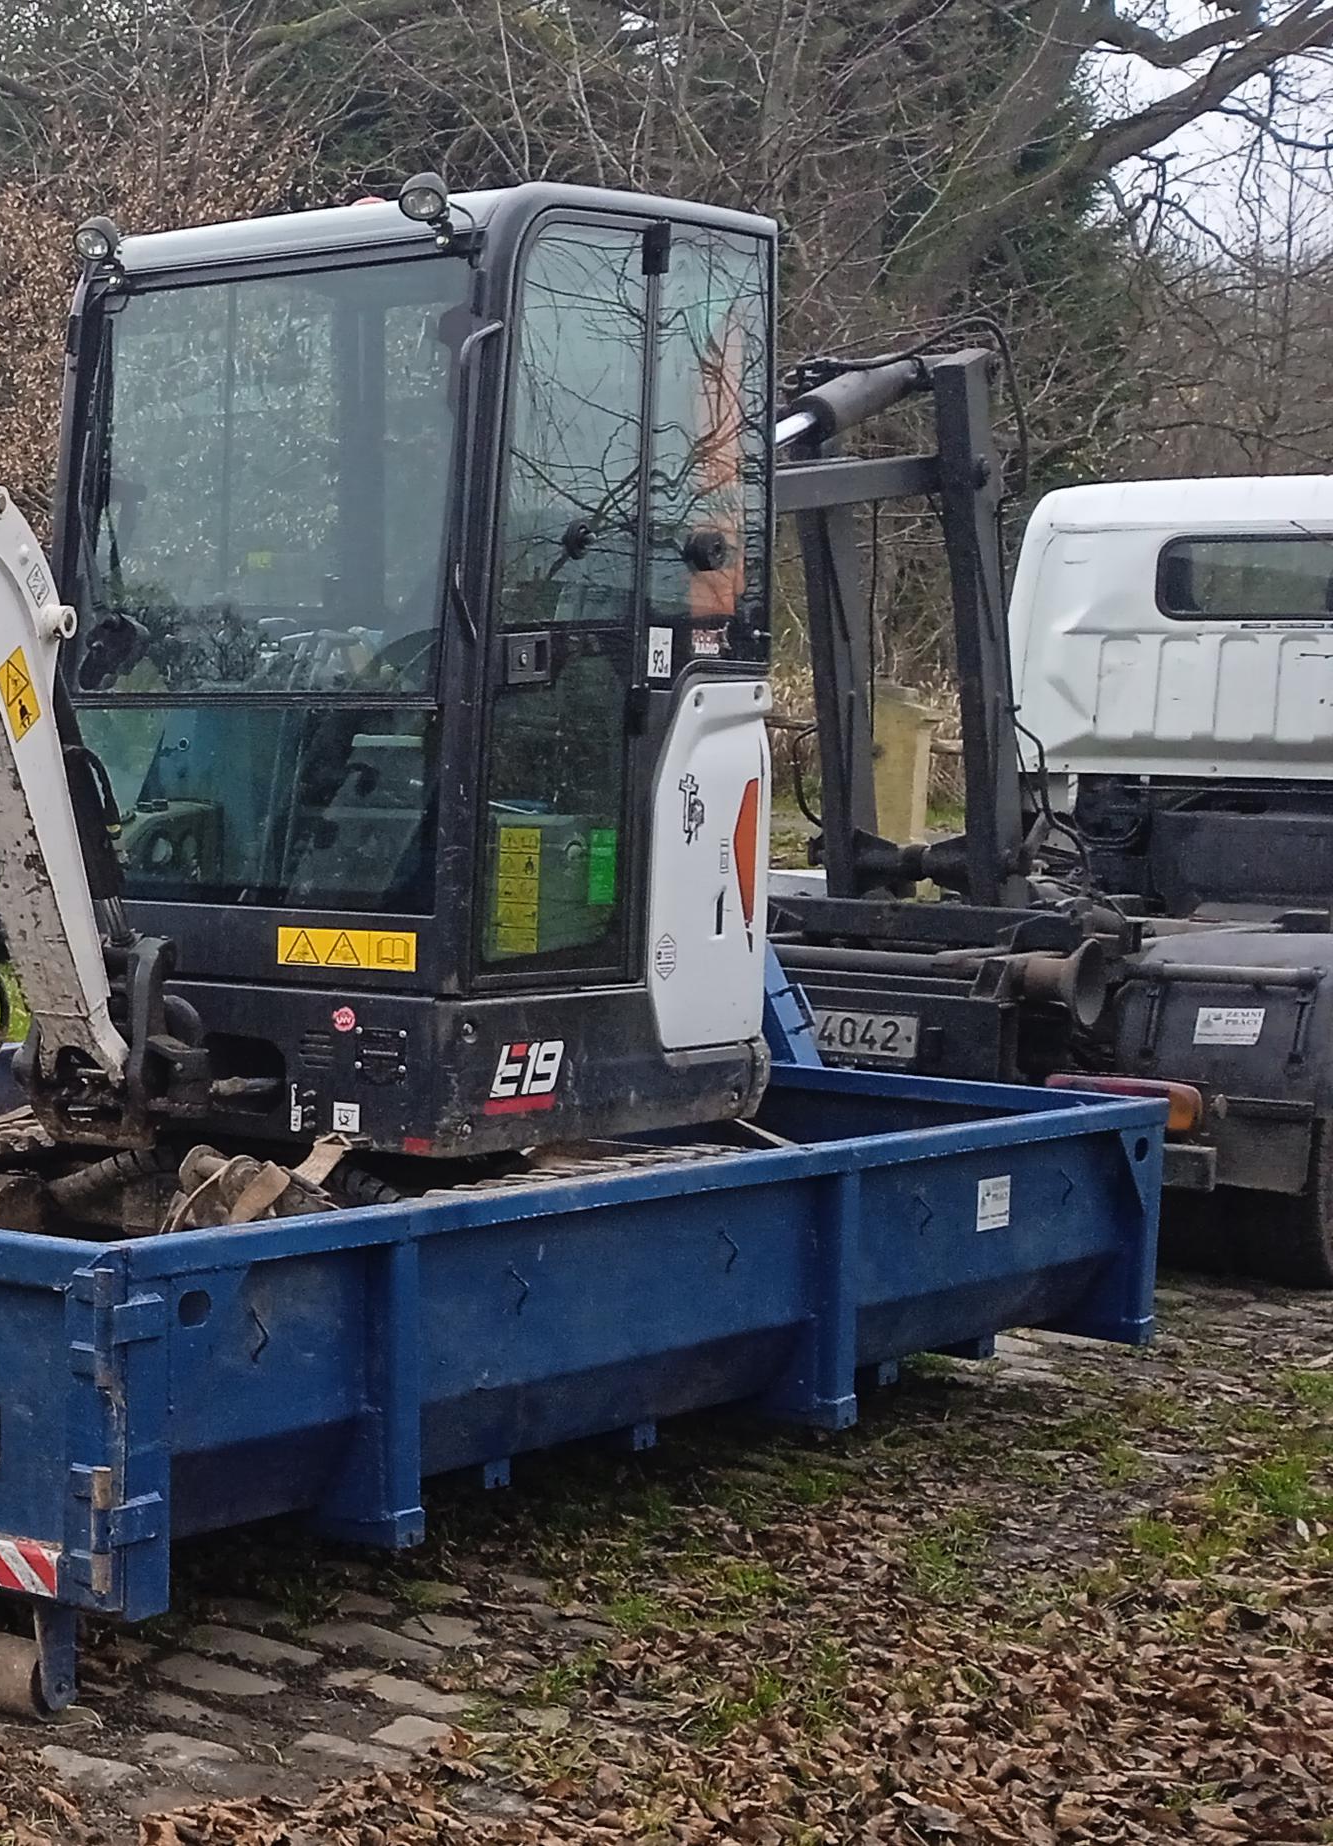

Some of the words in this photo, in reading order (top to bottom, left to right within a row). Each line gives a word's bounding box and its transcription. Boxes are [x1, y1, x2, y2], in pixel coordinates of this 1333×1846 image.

[653, 649, 665, 673] 93
[818, 1016, 900, 1052] 4042
[489, 1040, 564, 1098] E19
